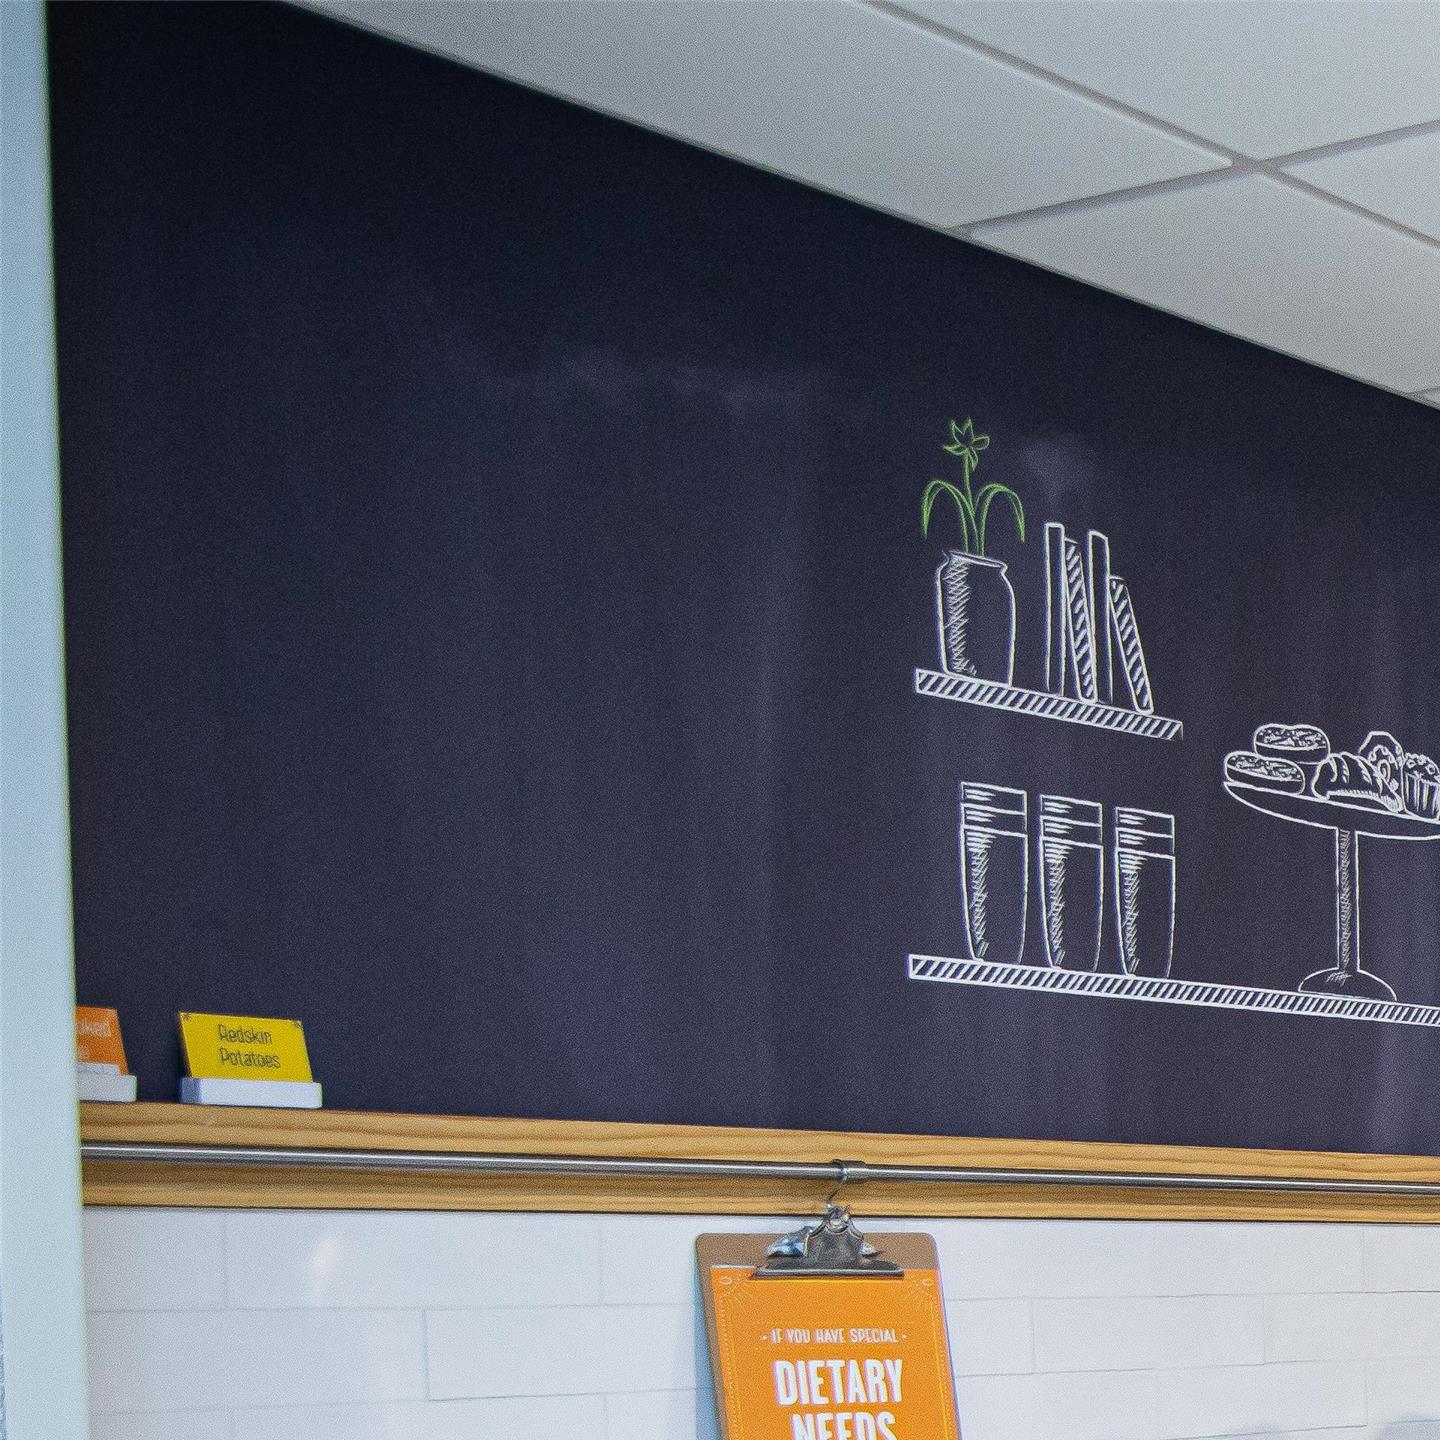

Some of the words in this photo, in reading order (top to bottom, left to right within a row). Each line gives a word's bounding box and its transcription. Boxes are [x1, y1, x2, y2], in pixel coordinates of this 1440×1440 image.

[217, 1024, 273, 1045] Redskin
[218, 1047, 281, 1069] Potatoes
[770, 1328, 782, 1343] IF
[786, 1328, 810, 1343] YOU
[815, 1328, 845, 1343] HAVE
[850, 1328, 899, 1343] SPECIAL
[774, 1359, 903, 1405] DIETARY
